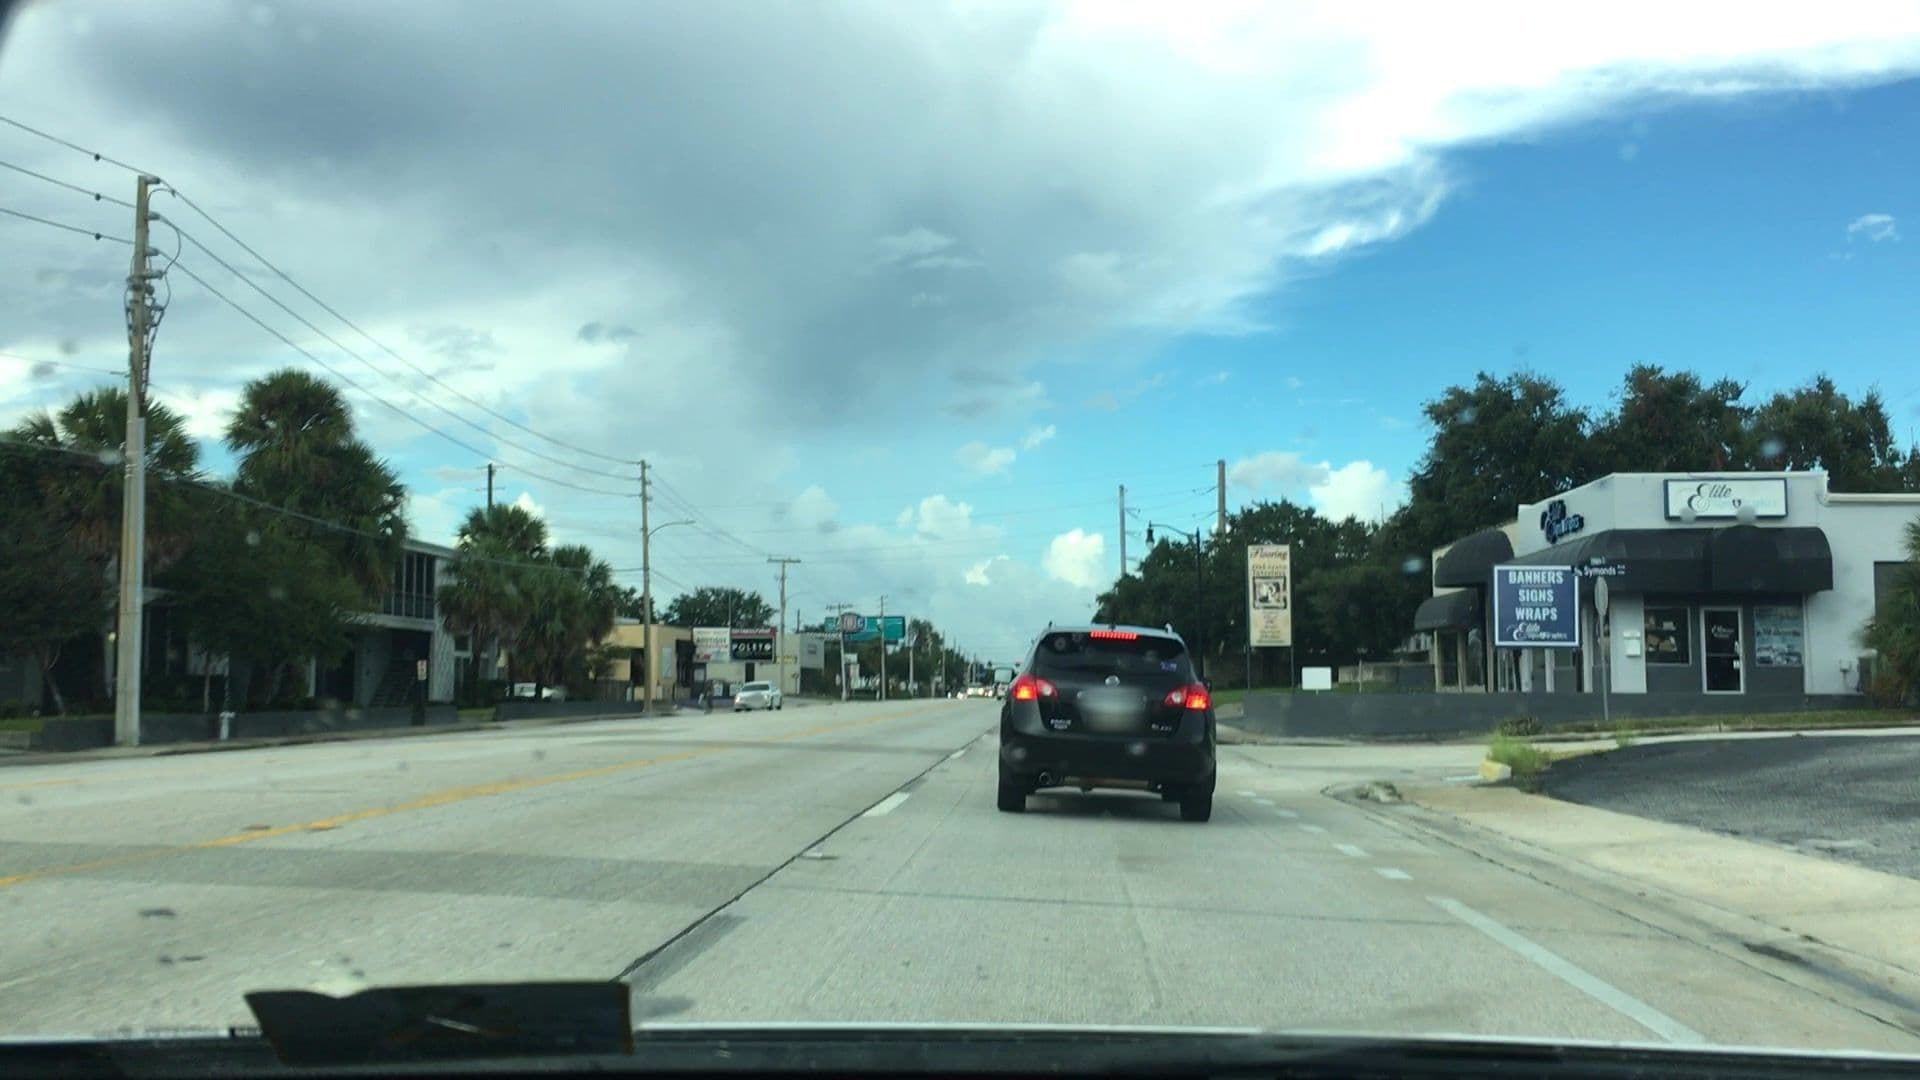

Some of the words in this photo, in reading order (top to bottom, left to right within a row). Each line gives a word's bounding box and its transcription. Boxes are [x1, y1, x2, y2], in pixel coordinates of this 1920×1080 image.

[1508, 570, 1564, 585] BANNERS
[1518, 589, 1554, 603] SIGNS
[1515, 607, 1558, 621] WRAPS
